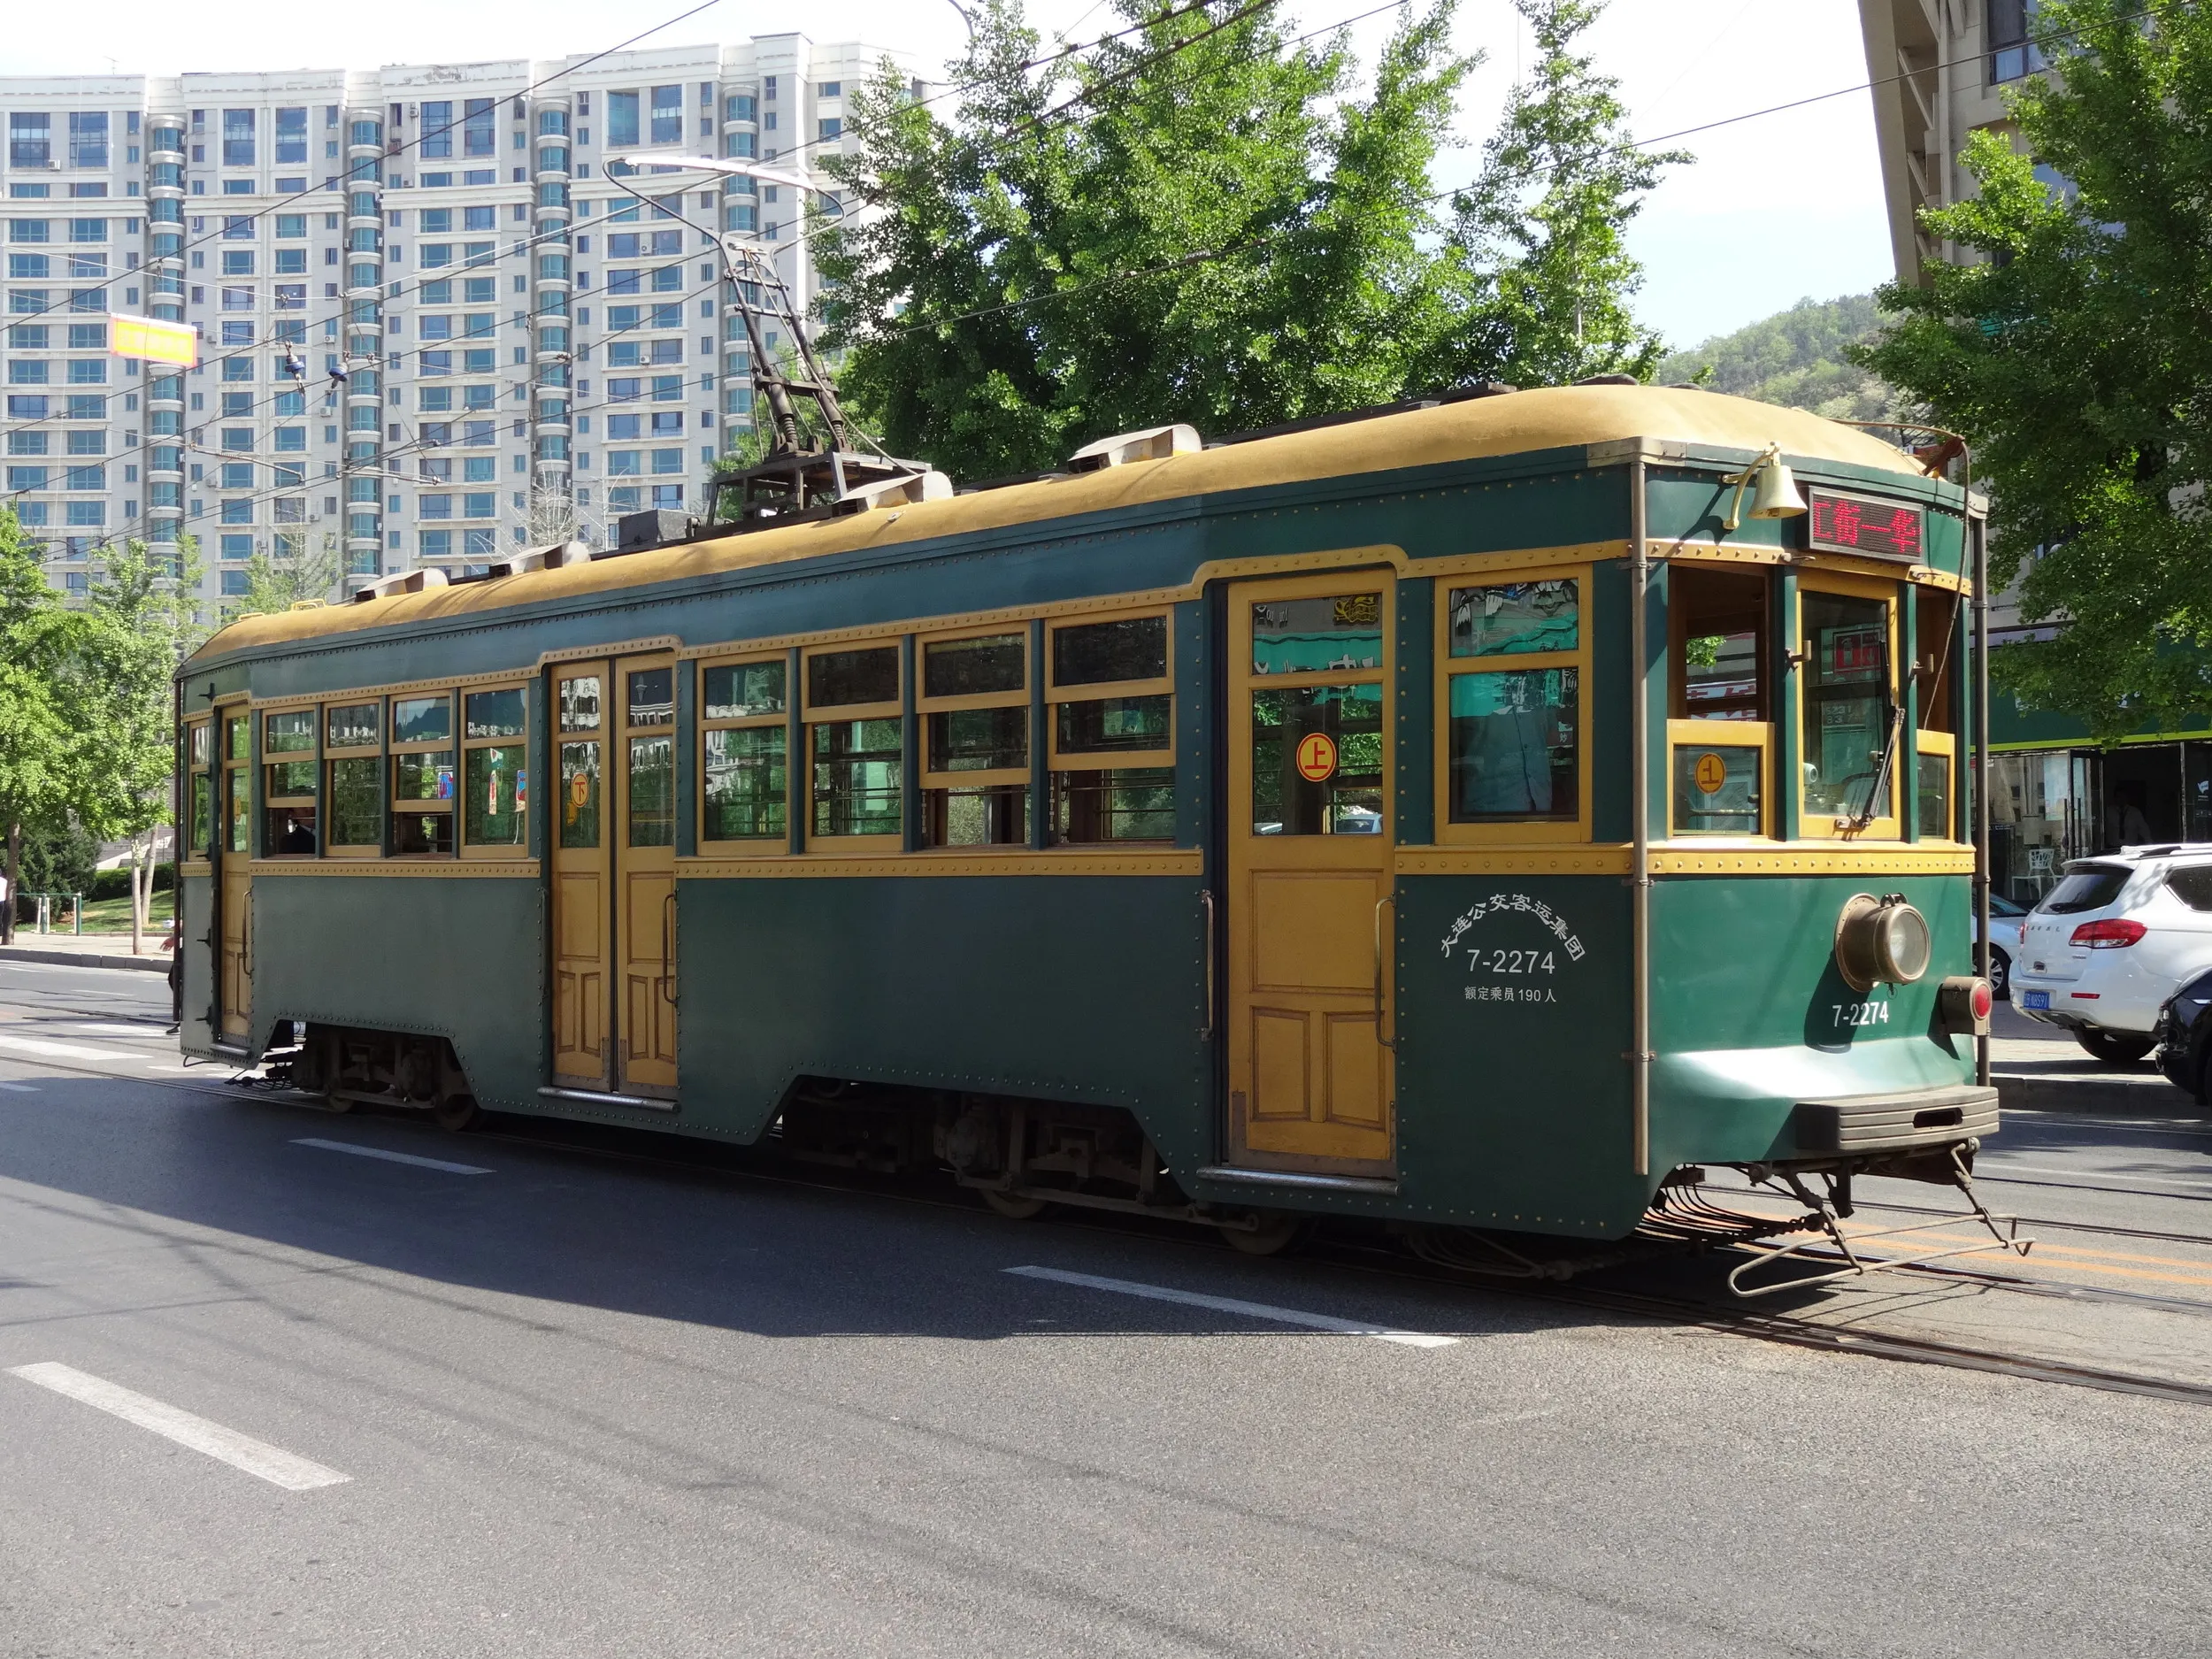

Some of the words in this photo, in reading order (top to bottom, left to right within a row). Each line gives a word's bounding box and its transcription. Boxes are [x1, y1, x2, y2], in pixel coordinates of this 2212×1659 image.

[1304, 741, 1328, 770] 上
[574, 781, 586, 802] 下
[1440, 893, 1586, 962] 大连公交客运集团
[1467, 949, 1555, 974] 7-2274
[1832, 1001, 1889, 1027] 7-2274
